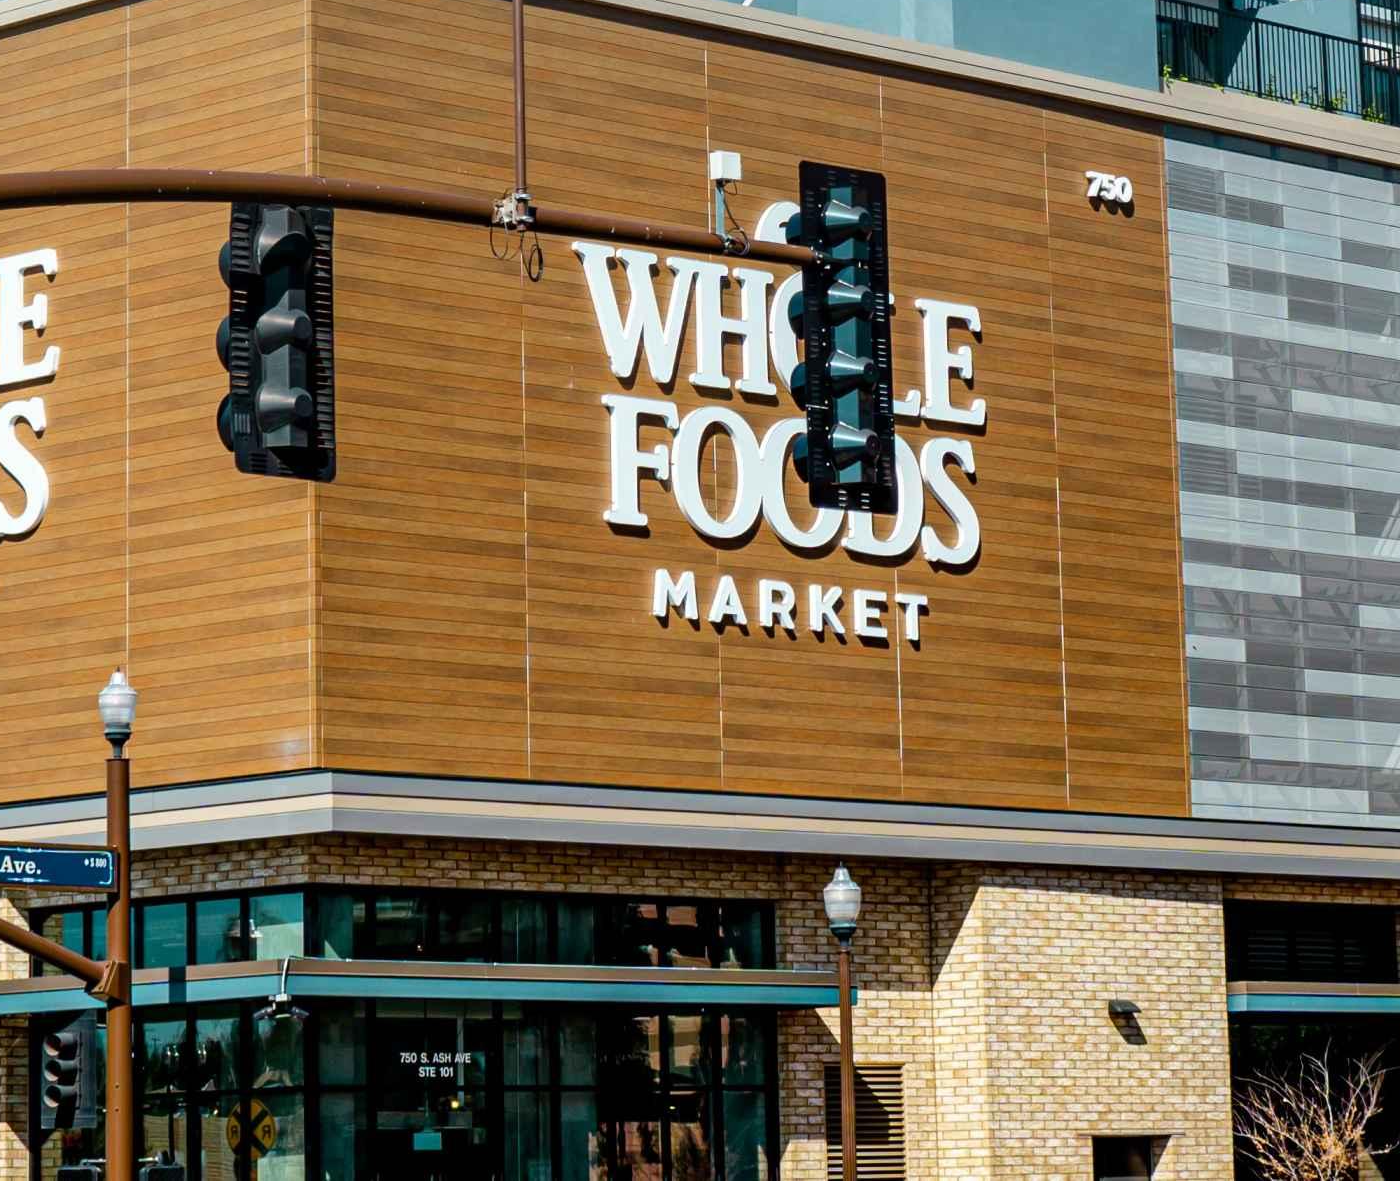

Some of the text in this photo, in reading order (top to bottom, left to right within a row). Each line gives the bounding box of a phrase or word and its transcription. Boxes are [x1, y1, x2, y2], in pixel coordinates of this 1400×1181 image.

[1085, 171, 1133, 203] 750
[571, 202, 986, 426] WHE
[653, 568, 928, 642] MARKET
[0, 855, 41, 875] Ave.
[400, 1052, 471, 1064] 750 S. ASH AVE
[418, 1067, 454, 1077] STE 101
